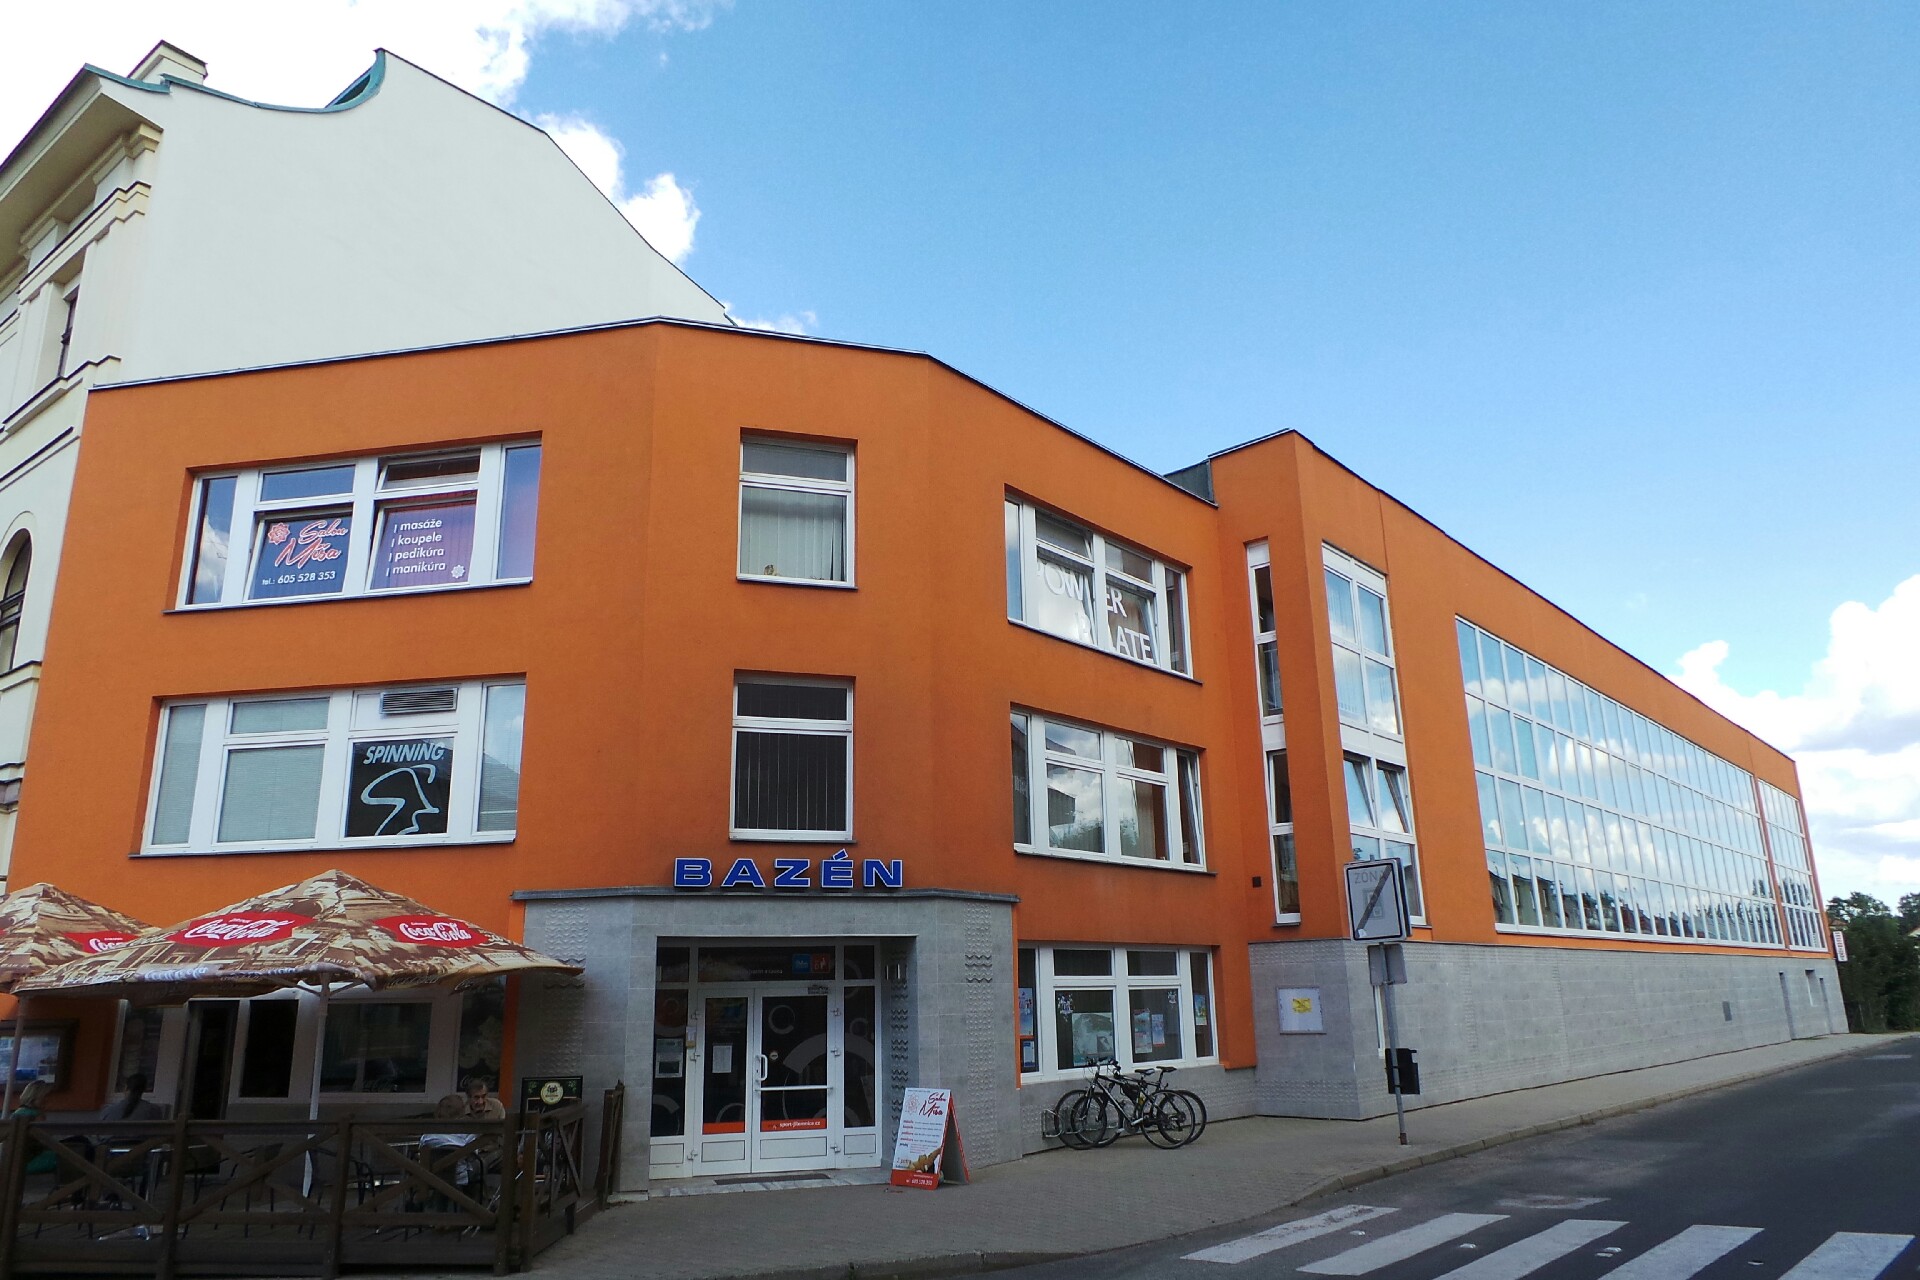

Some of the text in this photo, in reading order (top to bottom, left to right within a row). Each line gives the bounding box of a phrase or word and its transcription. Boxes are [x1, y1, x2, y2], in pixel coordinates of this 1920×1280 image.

[298, 518, 348, 544] Salon
[400, 518, 442, 531] masáže
[397, 531, 442, 546] koupele
[394, 547, 445, 562] pedikúra
[392, 561, 446, 574] manikúra
[277, 574, 296, 584] 605
[297, 572, 316, 582] 528
[317, 570, 336, 580] 353
[363, 741, 446, 765] SPINNING
[674, 848, 903, 888] BAZÉN
